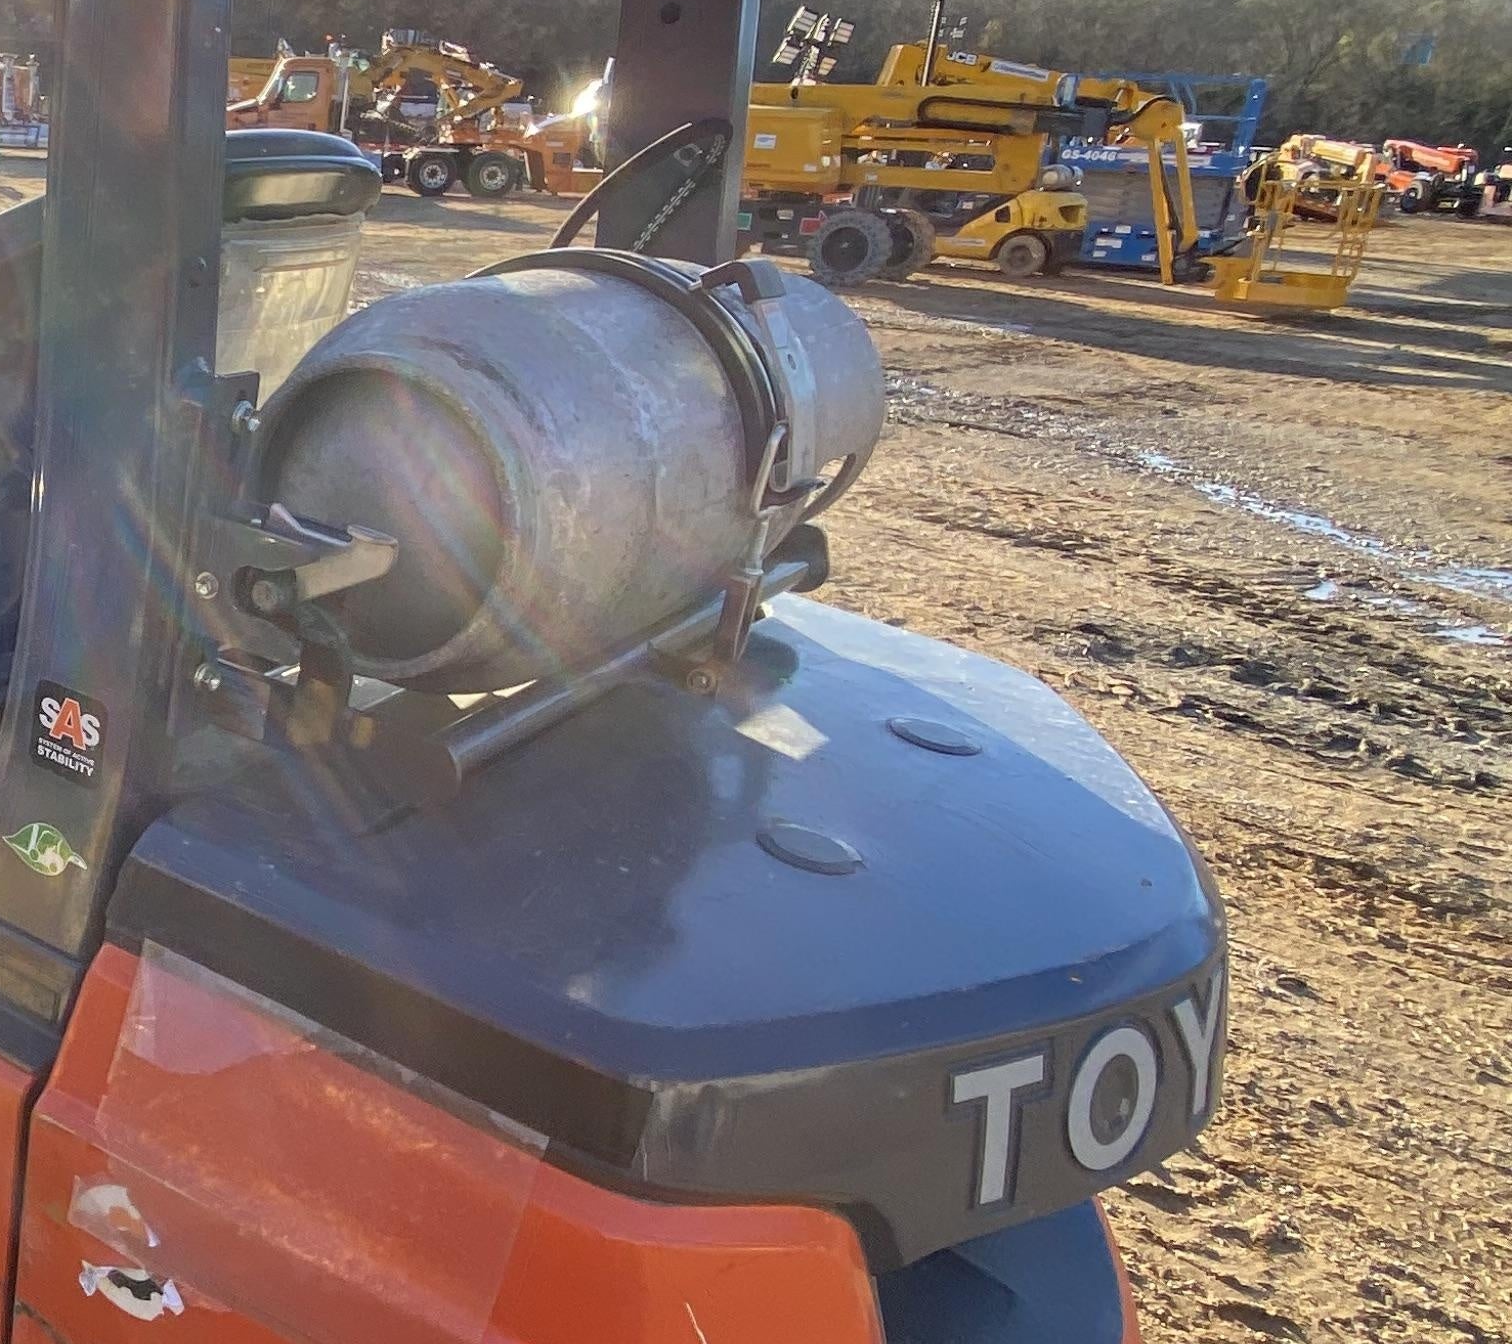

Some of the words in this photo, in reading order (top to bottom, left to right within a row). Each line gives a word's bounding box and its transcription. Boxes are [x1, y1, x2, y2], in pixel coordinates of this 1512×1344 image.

[946, 51, 978, 66] JCB
[39, 697, 100, 751] SAS
[37, 745, 94, 777] STABILITY
[953, 967, 1223, 1205] TOY
